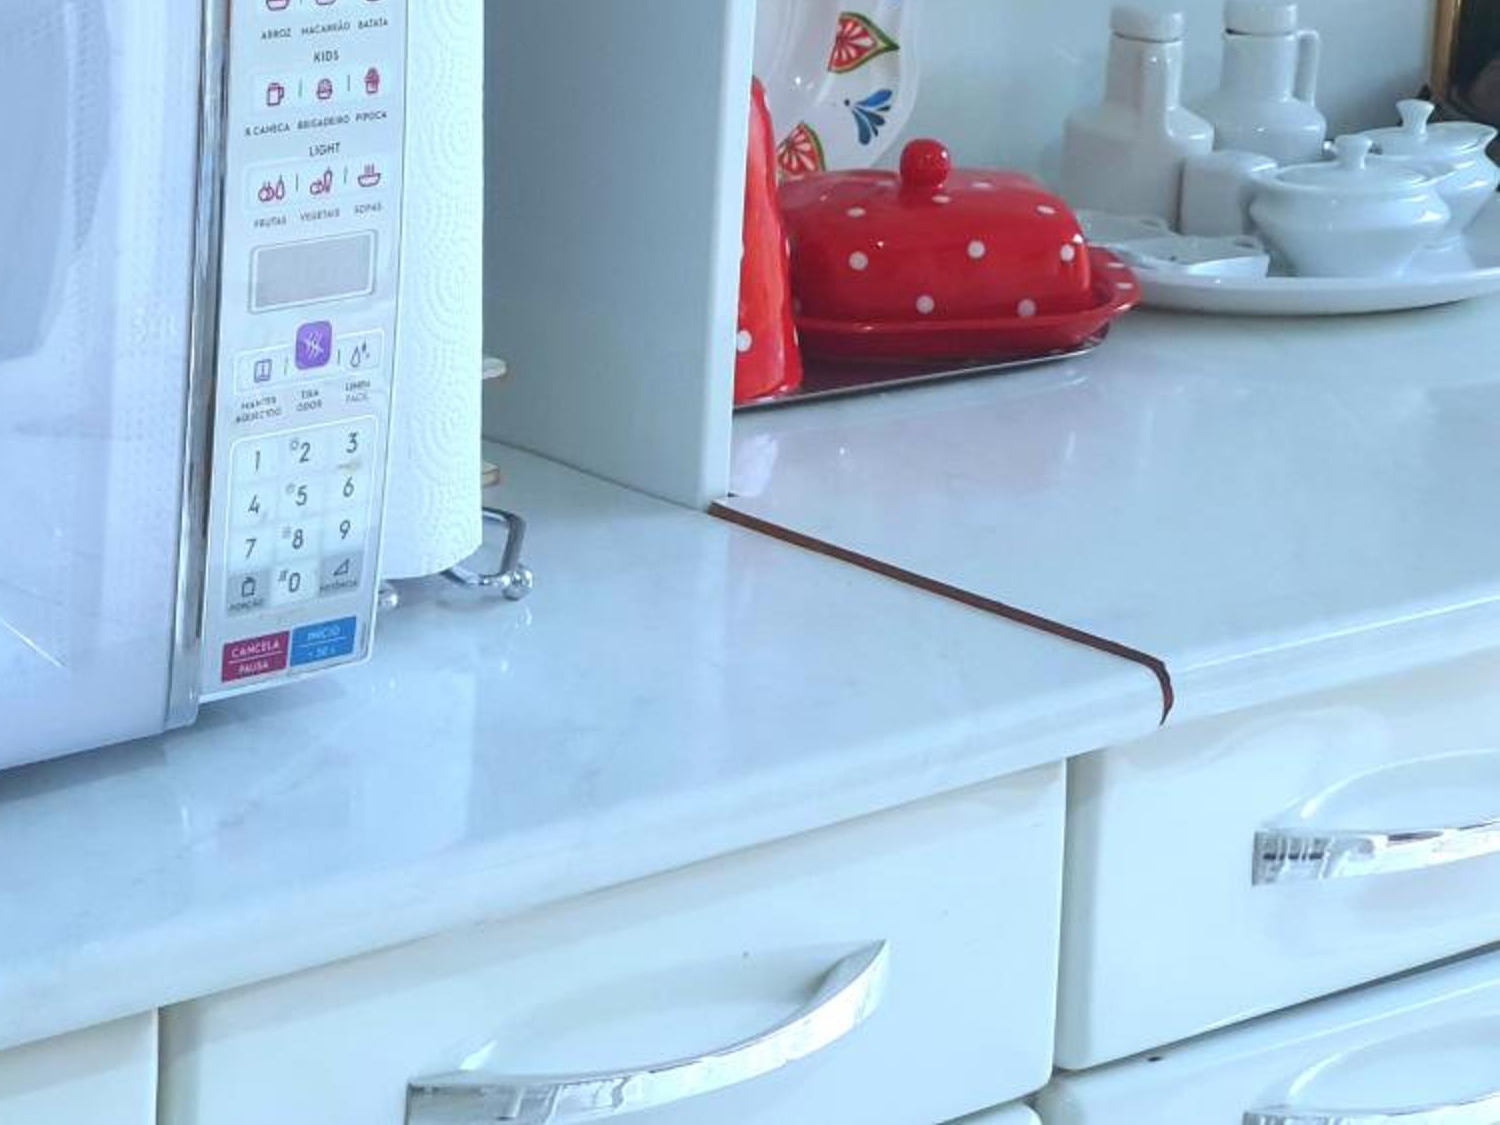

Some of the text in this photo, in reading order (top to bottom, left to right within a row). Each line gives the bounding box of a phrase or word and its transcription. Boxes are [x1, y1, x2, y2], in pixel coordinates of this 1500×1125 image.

[261, 28, 291, 40] ARROZ
[358, 17, 388, 30] BATATA
[313, 49, 340, 63] KIDS
[355, 111, 387, 122] PIPOCA
[308, 142, 340, 157] LIGHT
[299, 441, 311, 464] 2
[346, 431, 359, 454] 3
[255, 450, 261, 472] 1
[295, 484, 308, 507] 5
[343, 476, 355, 498] 6
[248, 494, 261, 514] 4
[291, 528, 304, 550] 8
[339, 519, 351, 540] 9
[245, 538, 257, 559] 7
[288, 572, 301, 593] 0
[231, 639, 280, 658] CANCELA
[238, 659, 269, 673] PAUSA
